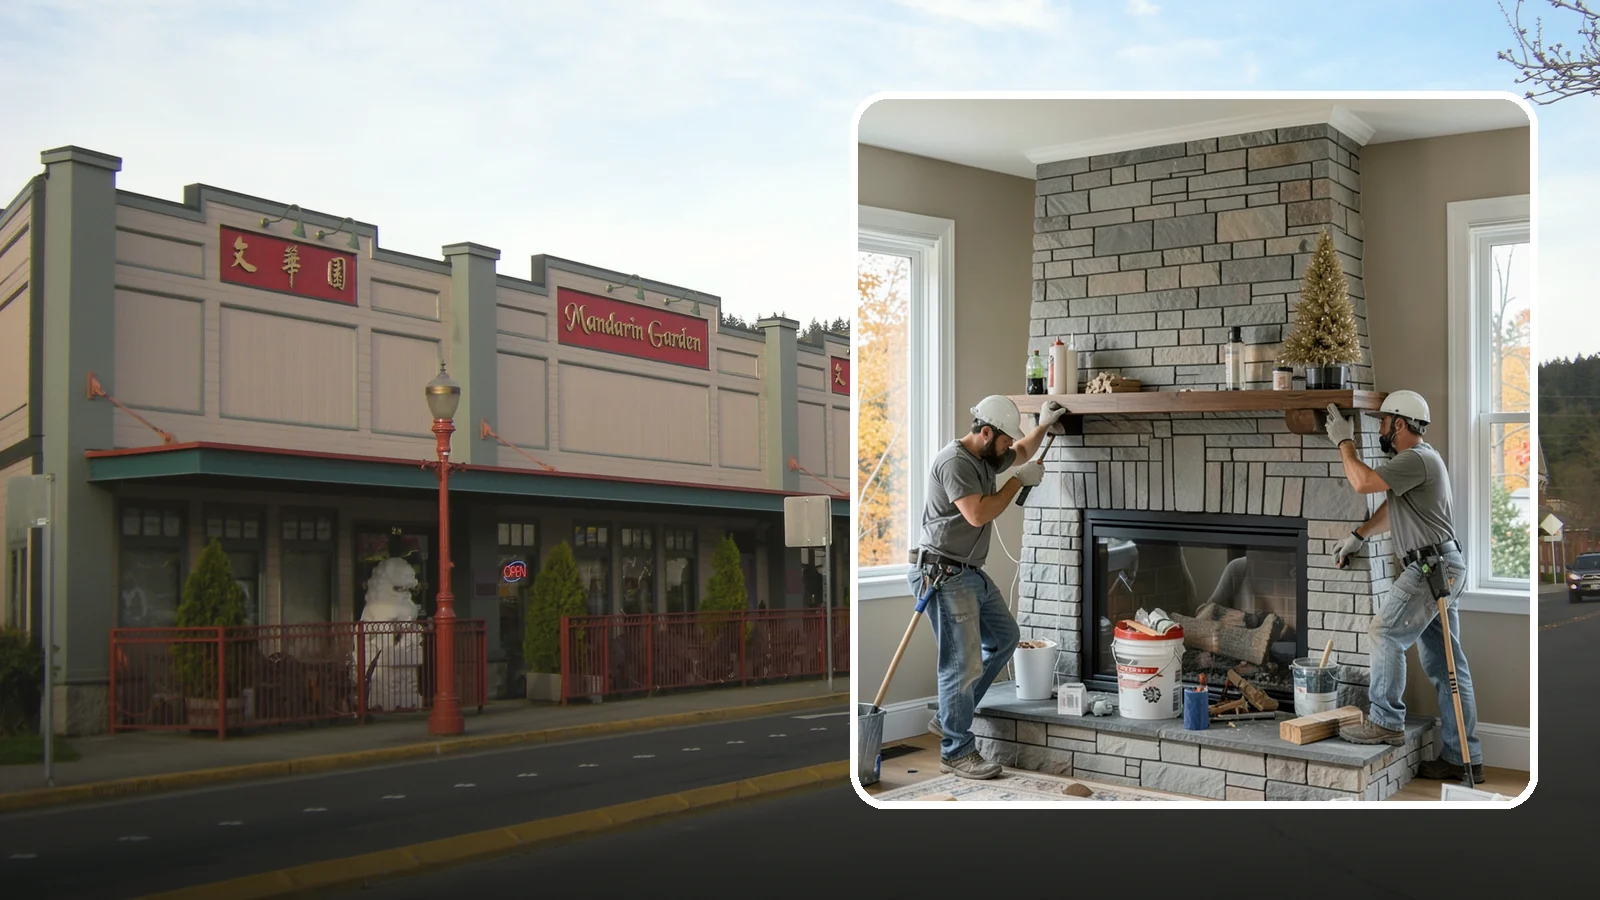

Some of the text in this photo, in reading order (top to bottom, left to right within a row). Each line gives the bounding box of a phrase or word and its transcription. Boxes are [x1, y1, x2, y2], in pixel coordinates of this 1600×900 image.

[231, 236, 346, 290] 文華園
[564, 302, 701, 352] Mandarin Garden
[503, 565, 527, 578] OPEN
